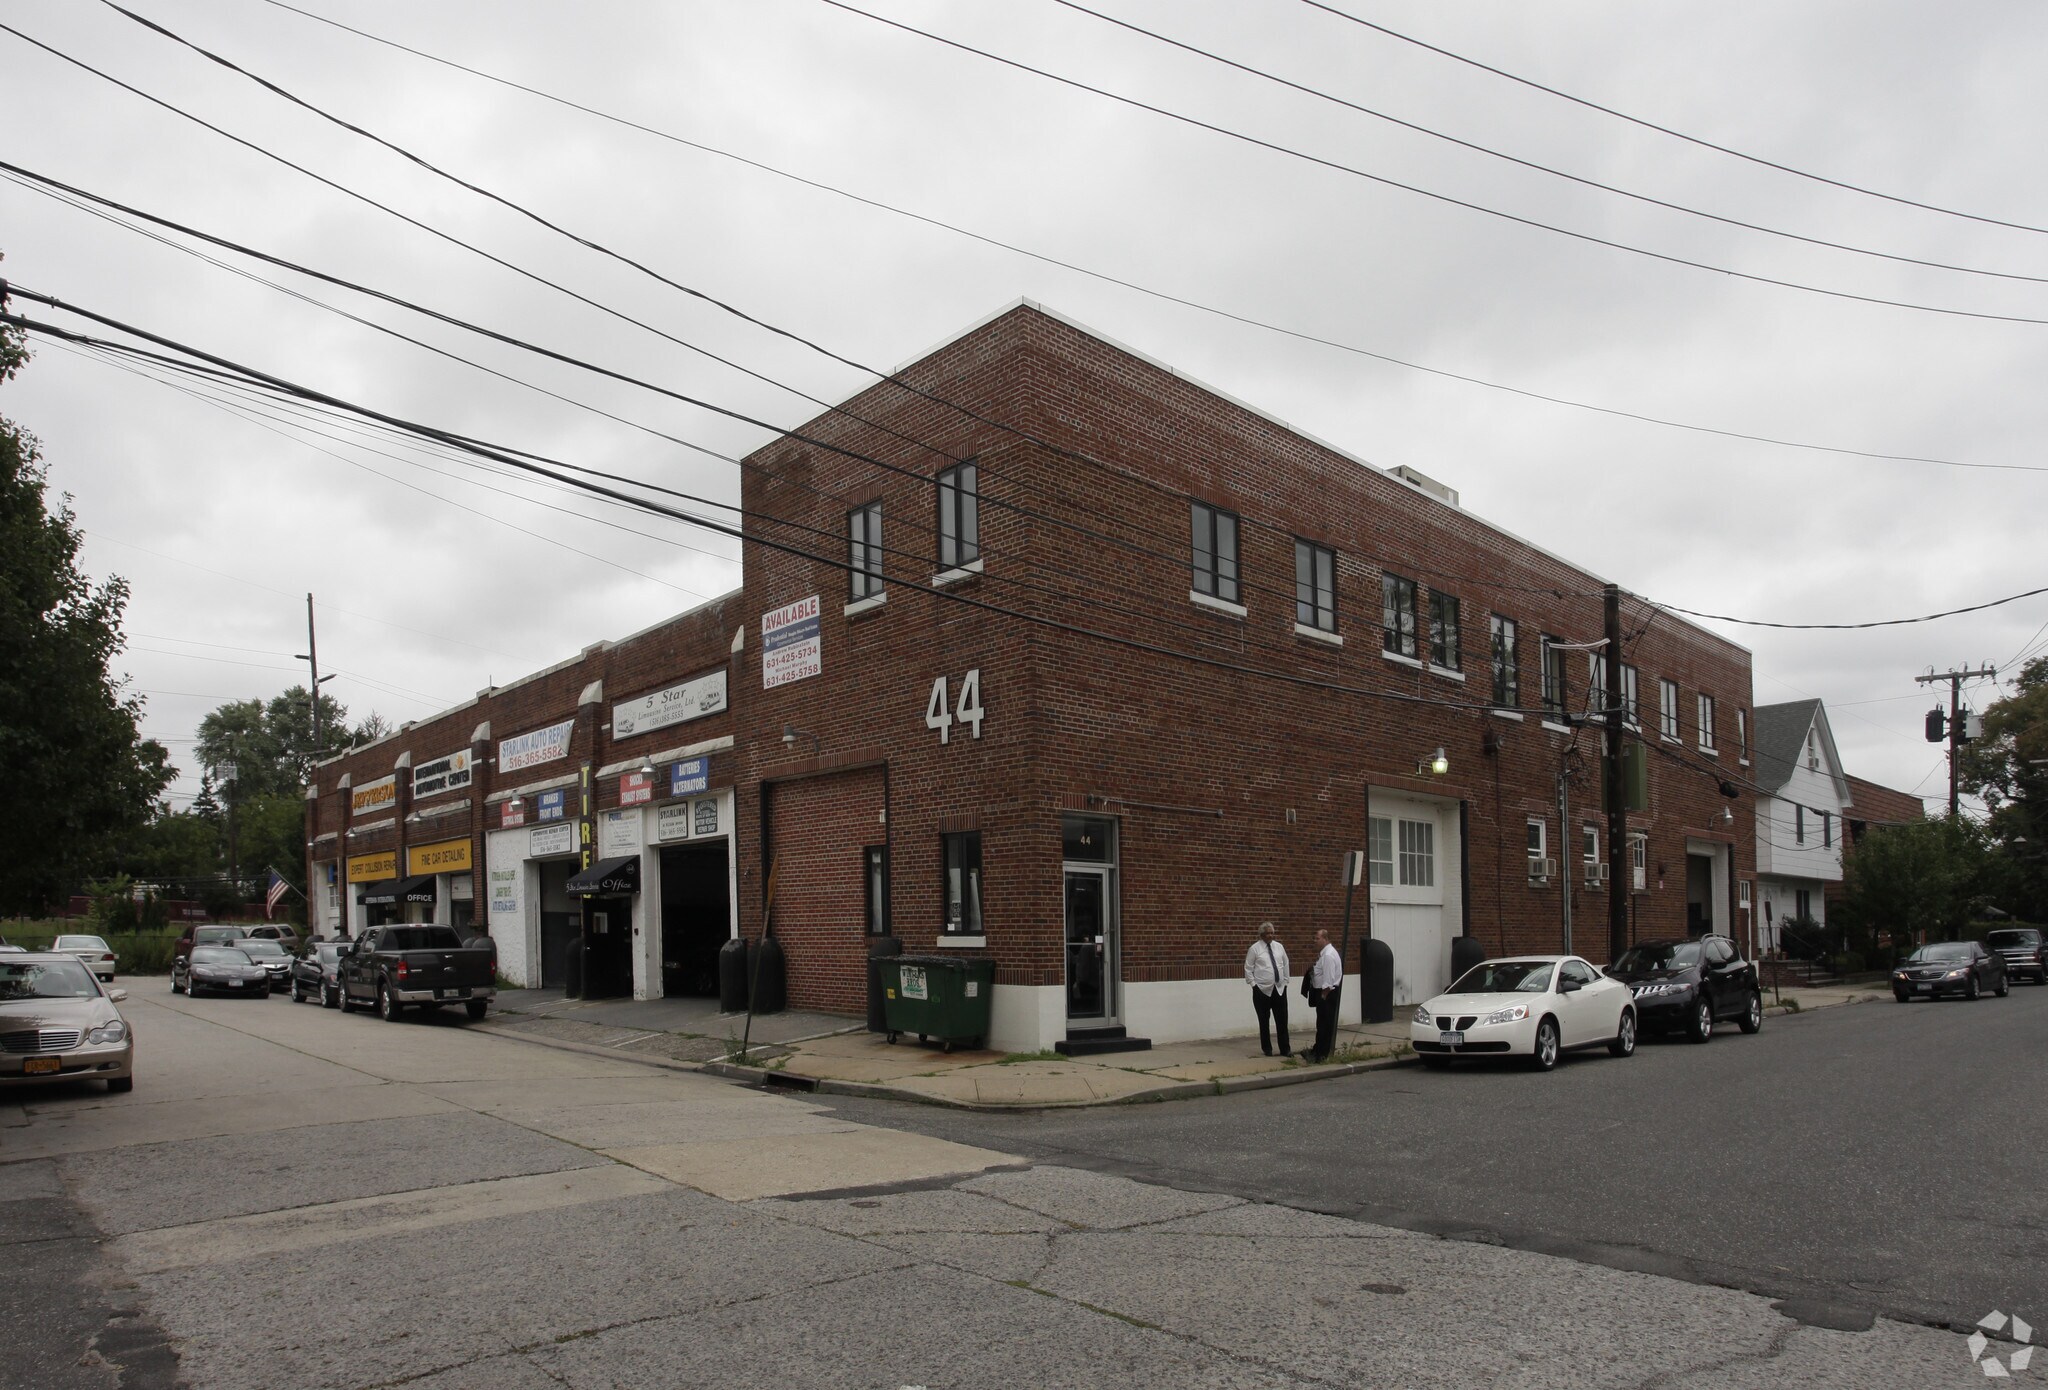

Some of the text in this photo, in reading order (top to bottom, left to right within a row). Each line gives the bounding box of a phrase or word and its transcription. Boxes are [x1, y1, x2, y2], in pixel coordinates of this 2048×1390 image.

[766, 599, 817, 631] AVAILABLE
[766, 645, 817, 669] 631-425-5734
[766, 664, 818, 687] 631-425-5758
[646, 689, 687, 709] 5 Star
[925, 668, 985, 745] 44
[502, 736, 531, 758] STARLINK
[530, 732, 547, 750] AUTO
[678, 761, 701, 776] BATTERIES
[415, 769, 470, 795] AUTOMOTIVE CENTER
[673, 777, 706, 794] ALTERNATORS
[543, 793, 559, 805] BRAKES
[552, 805, 563, 818] ENDS
[660, 807, 686, 819] STARLINK
[581, 766, 591, 899] TIRE
[1081, 835, 1091, 845] 44
[421, 848, 465, 865] FINE CAR DETAILING
[351, 863, 364, 875] EXPERT
[365, 861, 384, 873] COLLISION
[602, 879, 632, 891] Office
[407, 894, 433, 902] OFFICE
